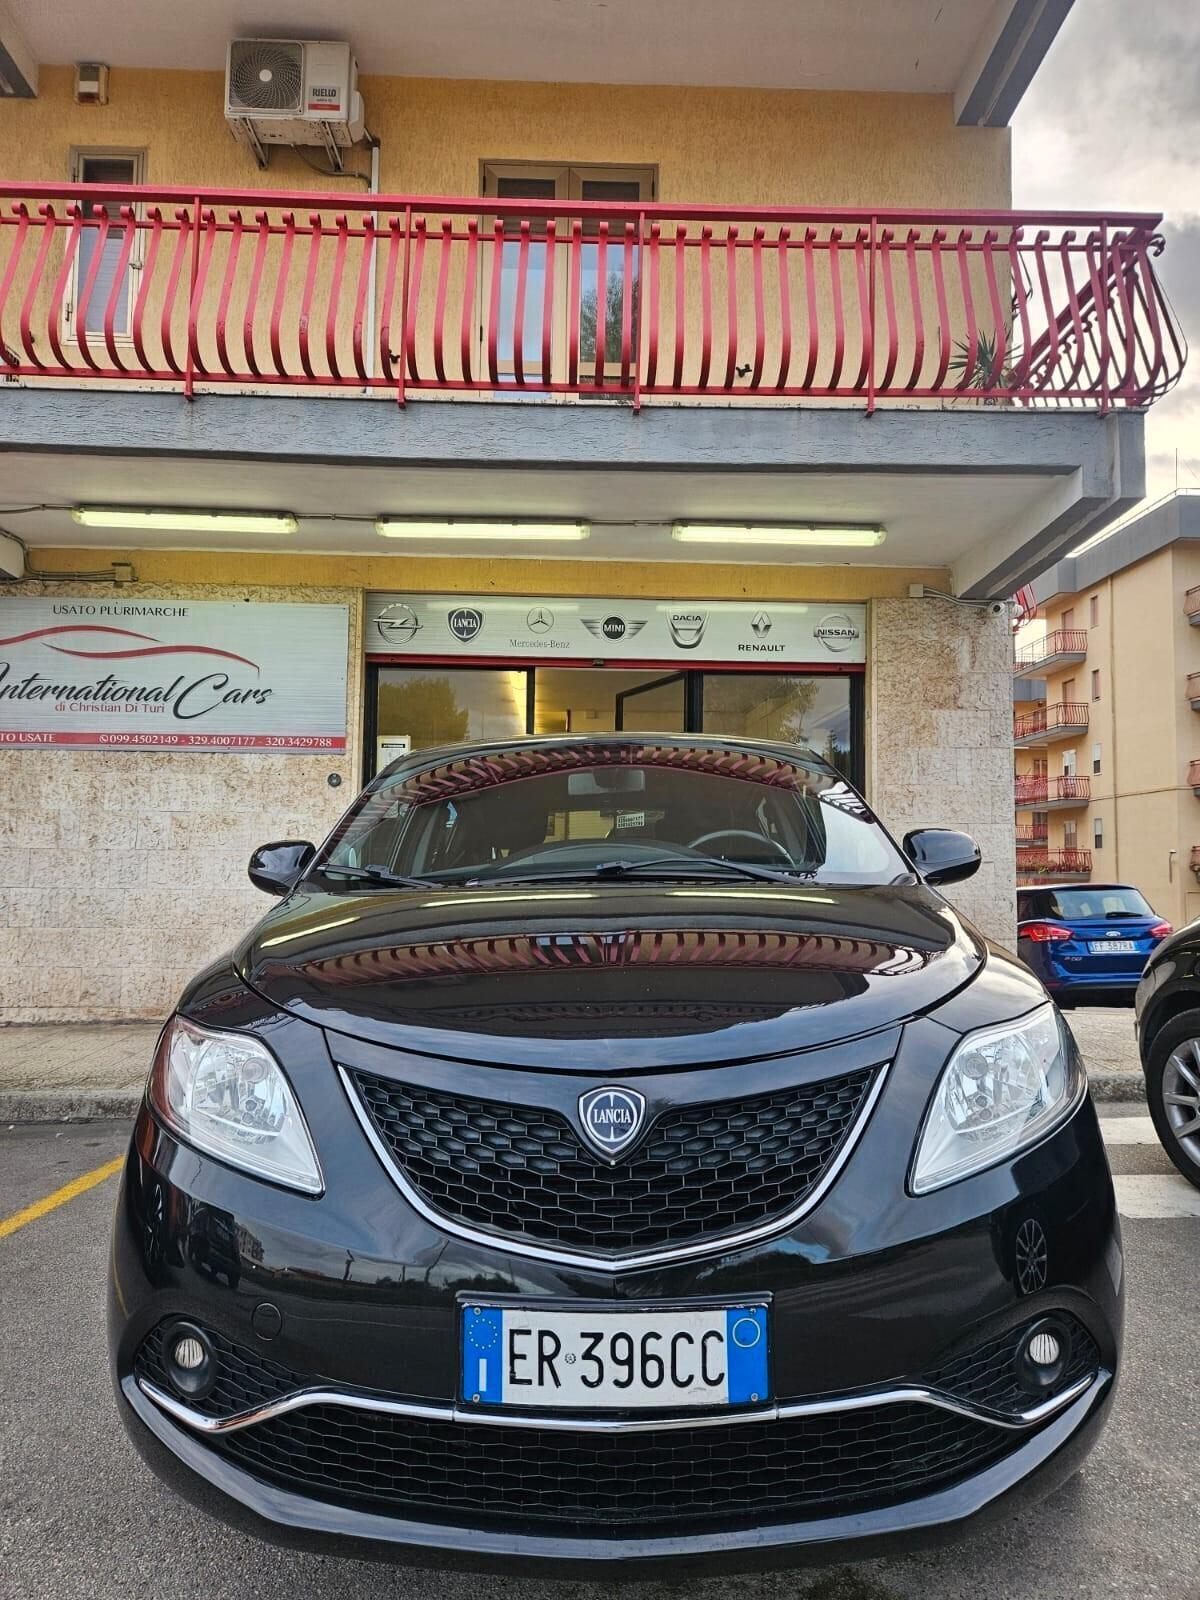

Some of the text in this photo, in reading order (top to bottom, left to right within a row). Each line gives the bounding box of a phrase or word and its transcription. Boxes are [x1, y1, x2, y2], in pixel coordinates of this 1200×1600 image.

[312, 88, 337, 98] RIELLO
[53, 604, 190, 617] USATO PLURIMARCHE
[454, 618, 477, 628] LANCIA
[672, 614, 702, 622] DACIA
[603, 624, 625, 633] MINI
[817, 628, 856, 637] NISSAN
[509, 639, 570, 649] Mercedes-Benz
[738, 644, 786, 652] RENAULT
[173, 672, 273, 719] Cars
[55, 702, 165, 713] di Christian Di Turi
[19, 732, 57, 743] USATE
[109, 734, 178, 744] 099.4502149
[188, 735, 256, 746] 329.4007177
[265, 736, 332, 747] 320.3429788
[593, 1109, 632, 1123] LANCIA
